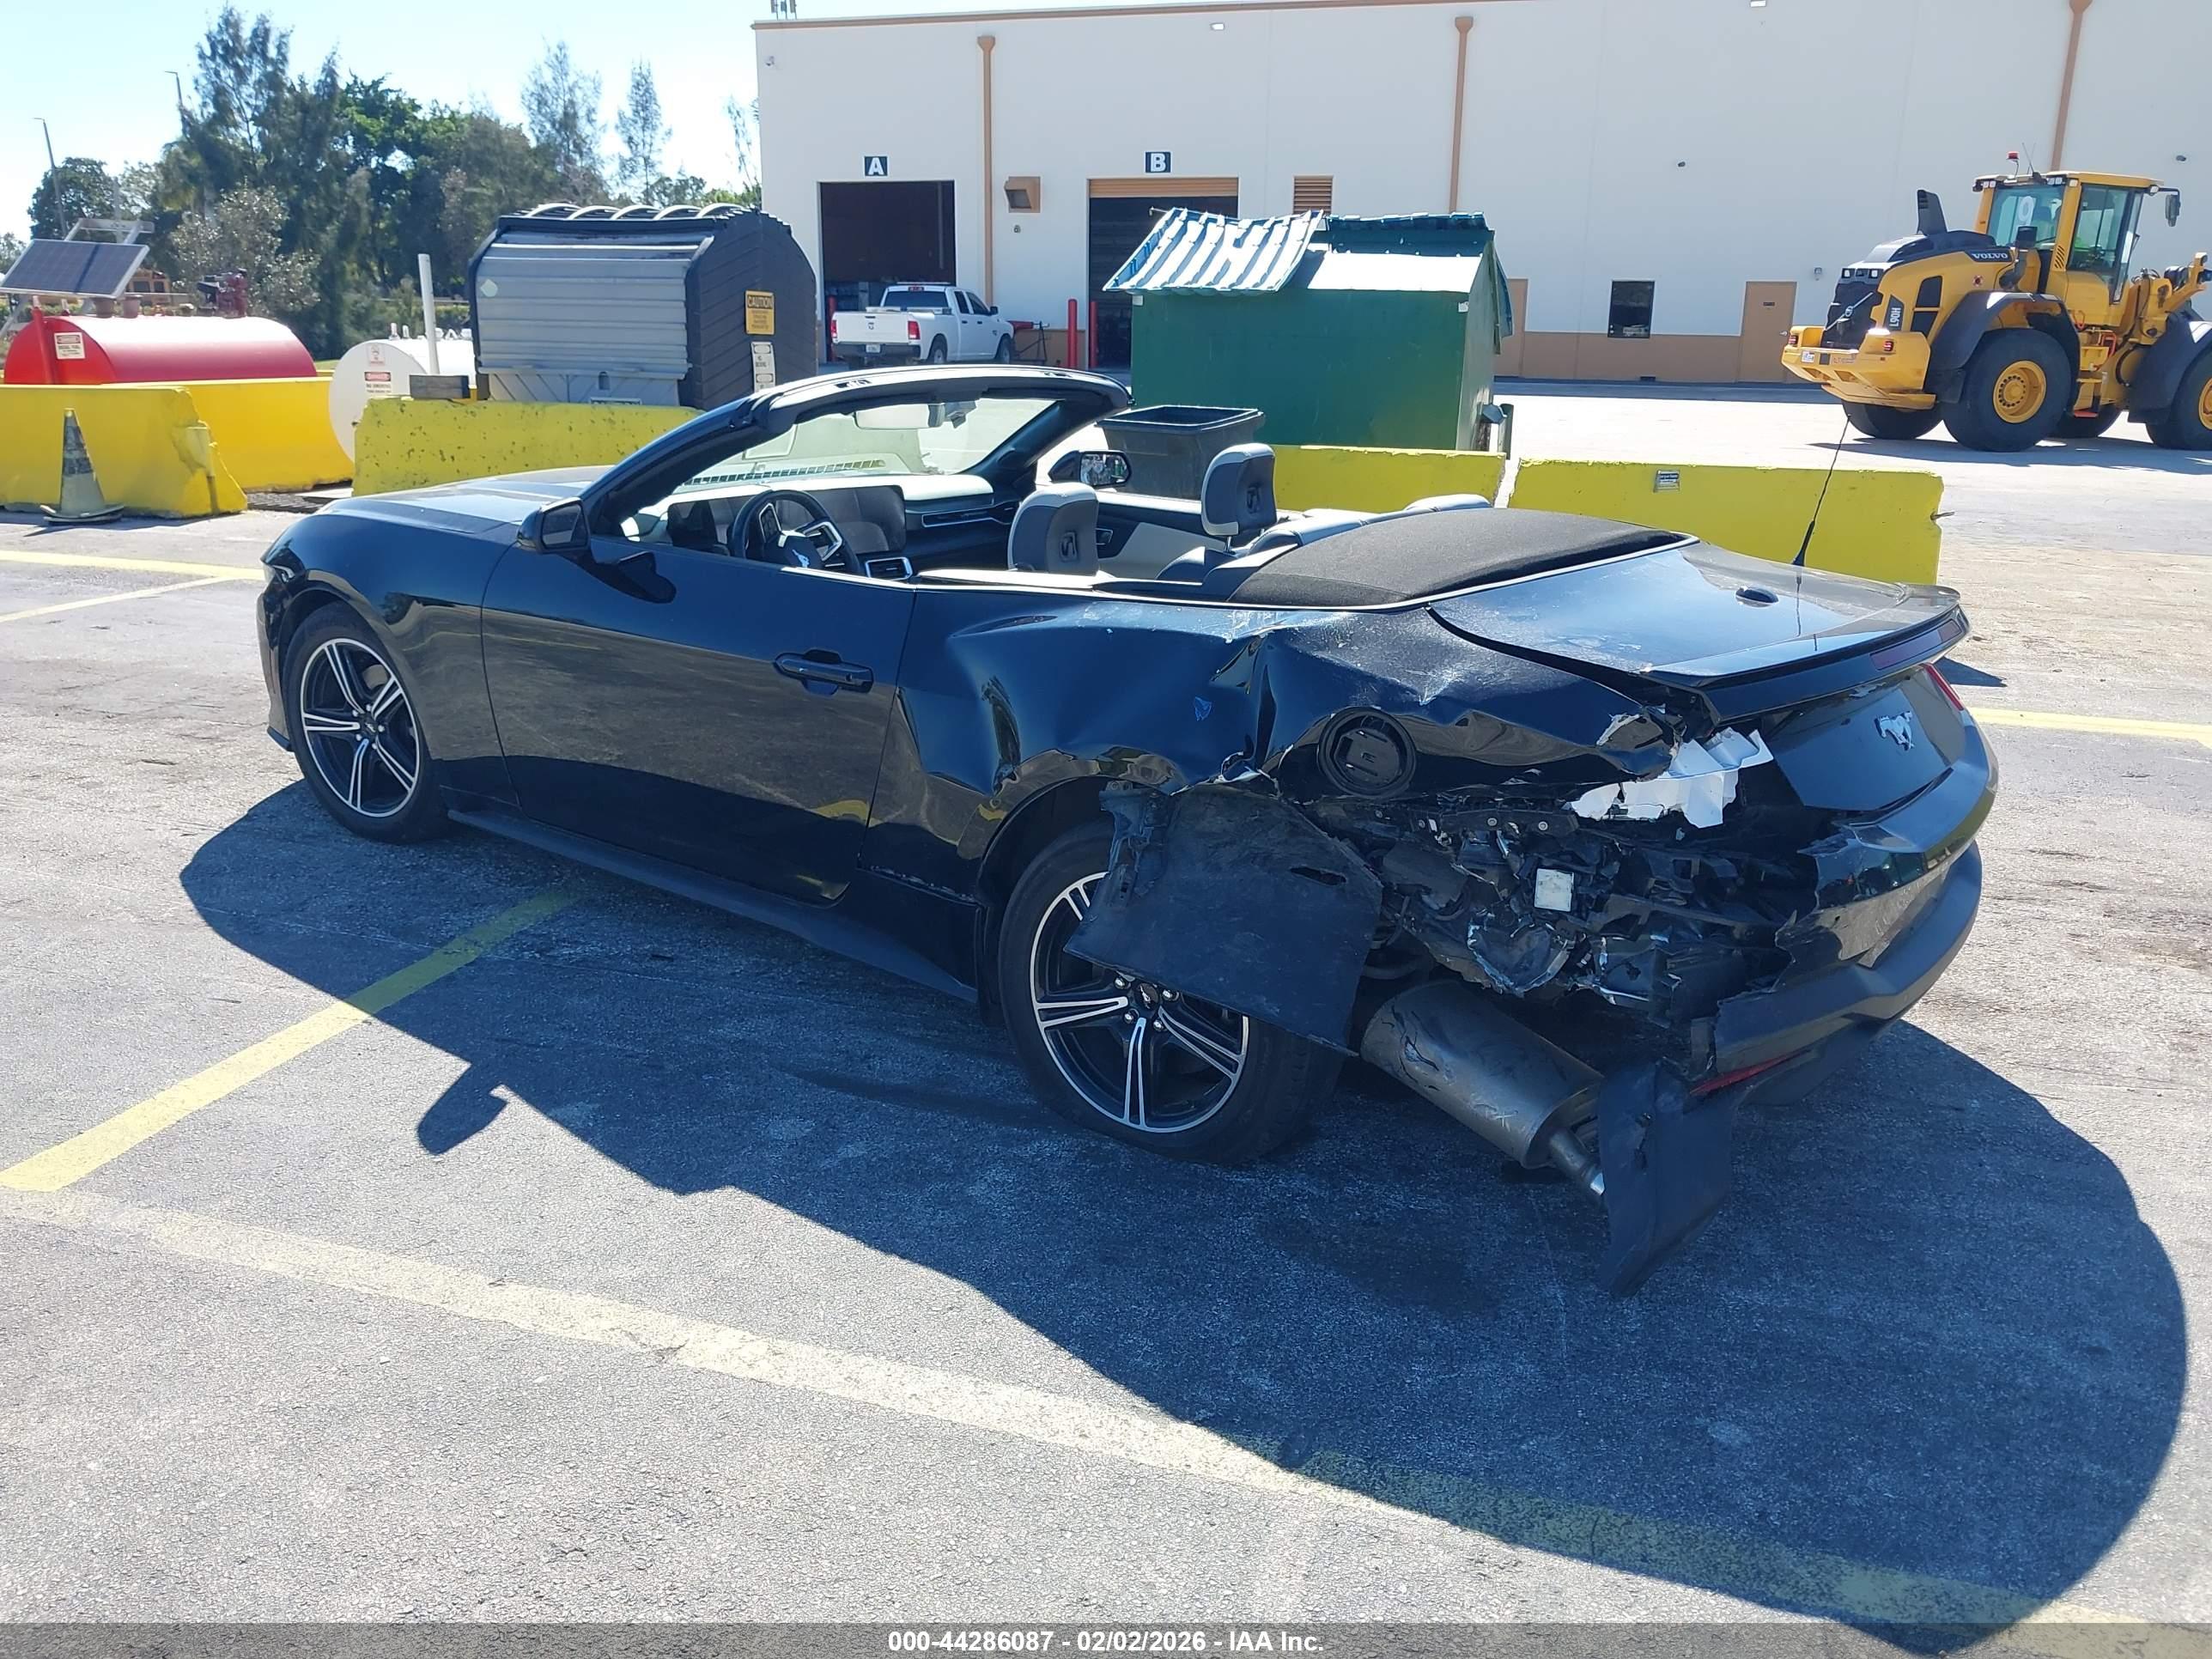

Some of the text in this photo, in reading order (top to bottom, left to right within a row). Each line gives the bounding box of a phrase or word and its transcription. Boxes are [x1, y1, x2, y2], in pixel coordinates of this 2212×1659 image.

[868, 158, 884, 175] A
[1151, 153, 1166, 173] B
[748, 295, 773, 309] CAUTION
[1889, 307, 1901, 327] L90H
